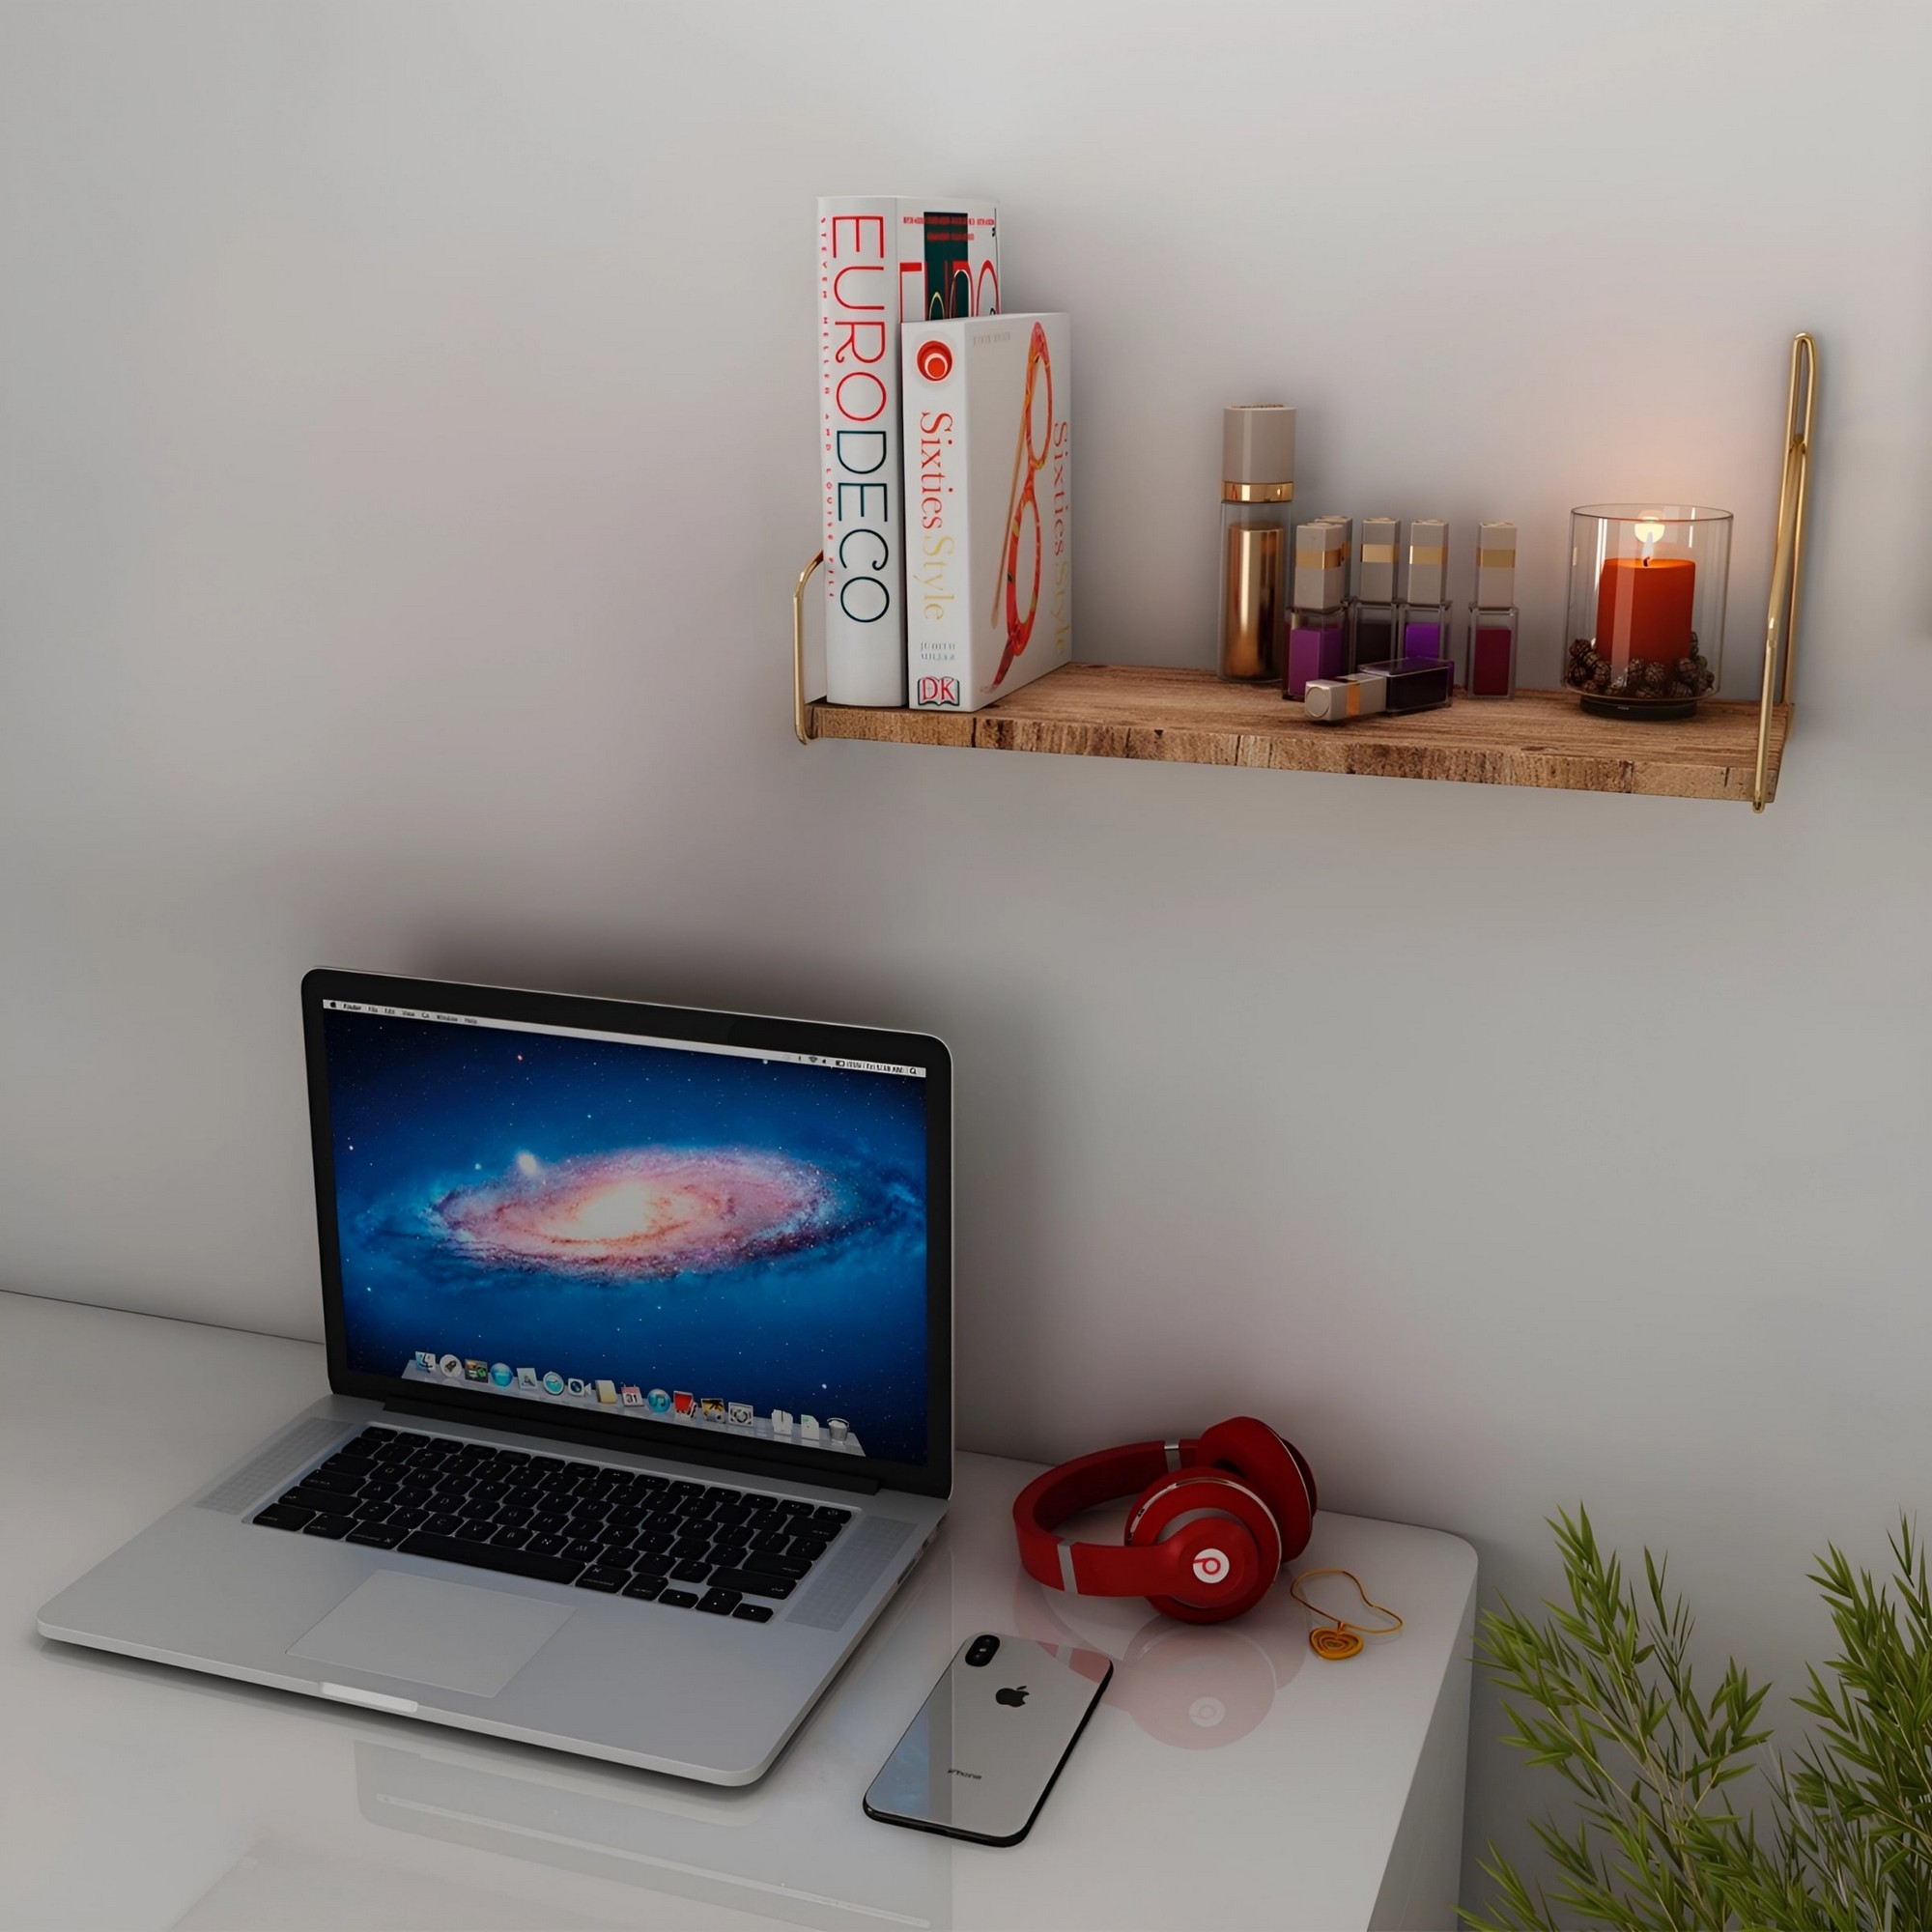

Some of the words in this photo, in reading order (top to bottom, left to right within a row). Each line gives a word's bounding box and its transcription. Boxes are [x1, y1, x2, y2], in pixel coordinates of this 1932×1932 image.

[921, 412, 953, 529] Sixties
[1053, 421, 1068, 556] Sixties
[912, 534, 954, 620] Style
[922, 676, 956, 701] DK
